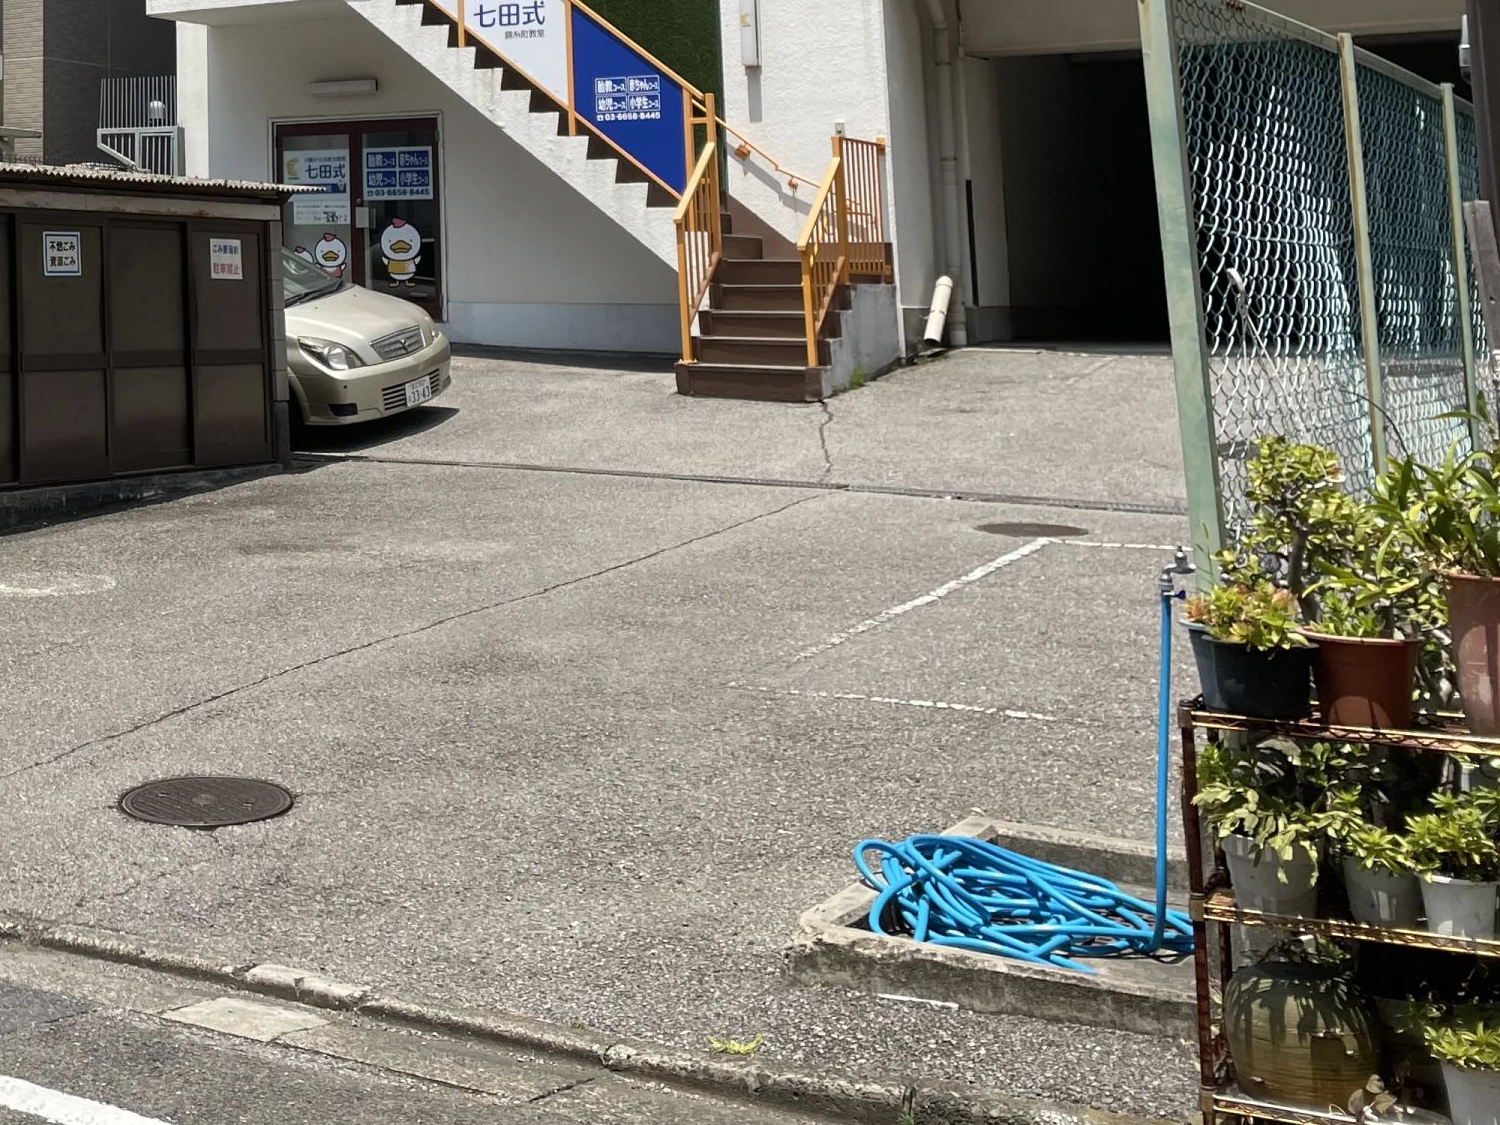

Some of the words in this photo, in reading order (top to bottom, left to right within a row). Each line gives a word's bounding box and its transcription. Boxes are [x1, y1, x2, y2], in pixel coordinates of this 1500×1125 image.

[473, 0, 546, 28] 七田式
[504, 29, 545, 40] 錦糸町教室
[629, 96, 659, 110] 小学生コース
[304, 163, 347, 179] 七田式
[399, 170, 429, 187] 小学生コース
[49, 241, 76, 252] 不燃ごみ
[213, 262, 241, 275] 駐車禁止
